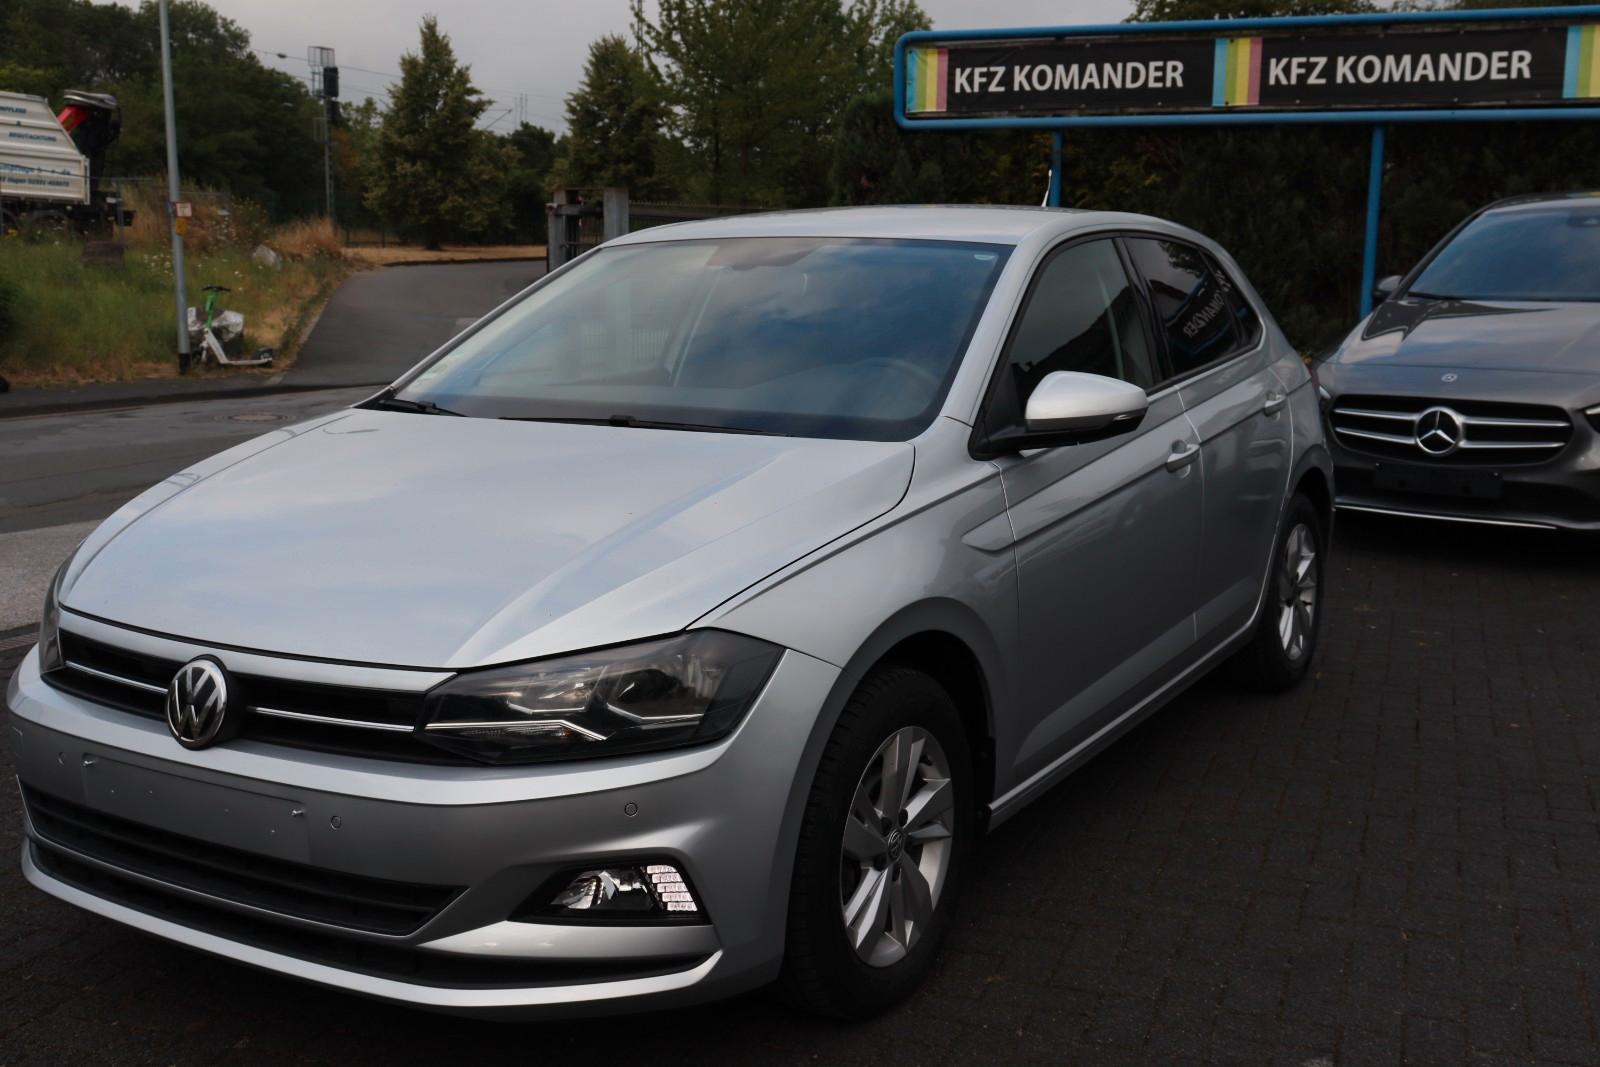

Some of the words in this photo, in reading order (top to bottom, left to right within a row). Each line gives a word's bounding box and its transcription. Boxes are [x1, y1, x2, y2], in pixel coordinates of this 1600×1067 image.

[955, 66, 1006, 93] KFZ
[1013, 60, 1184, 91] KOMANDER
[1269, 57, 1328, 85] KFZ
[1336, 50, 1532, 83] KOMANDER
